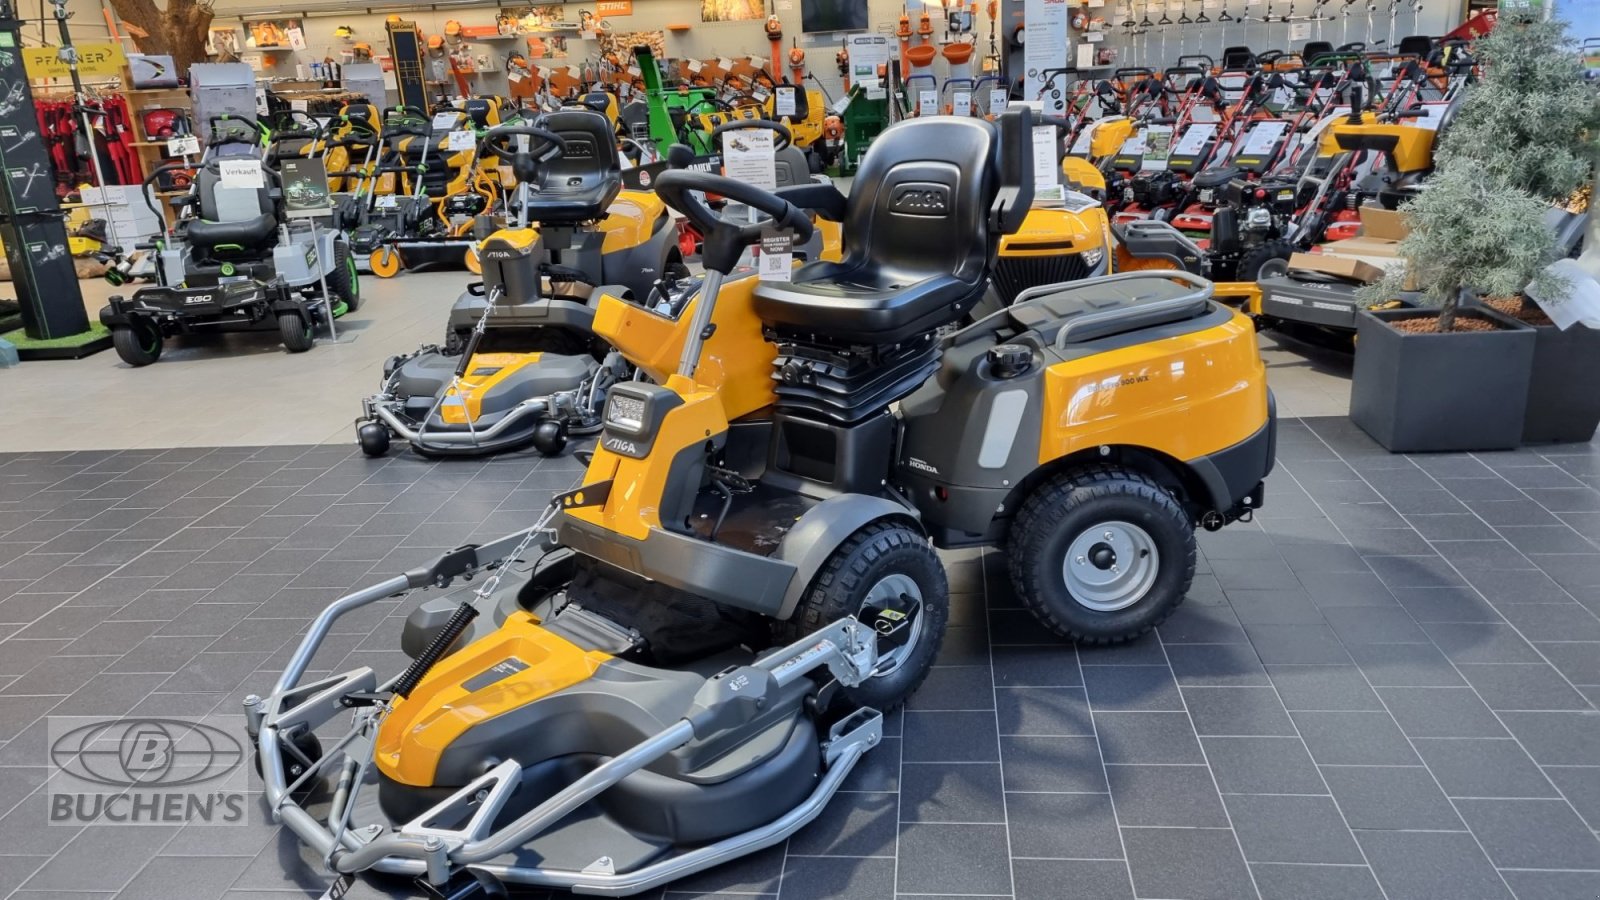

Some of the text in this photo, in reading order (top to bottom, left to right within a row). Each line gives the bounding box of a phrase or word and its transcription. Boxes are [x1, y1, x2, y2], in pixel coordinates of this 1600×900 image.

[600, 2, 626, 10] STIHL
[35, 53, 105, 65] PFANER
[225, 168, 257, 176] Verkauft
[895, 190, 945, 209] STIGA
[186, 294, 212, 304] EGO
[1136, 375, 1149, 383] WX
[606, 438, 636, 454] STIGA
[909, 460, 939, 475] HONDA
